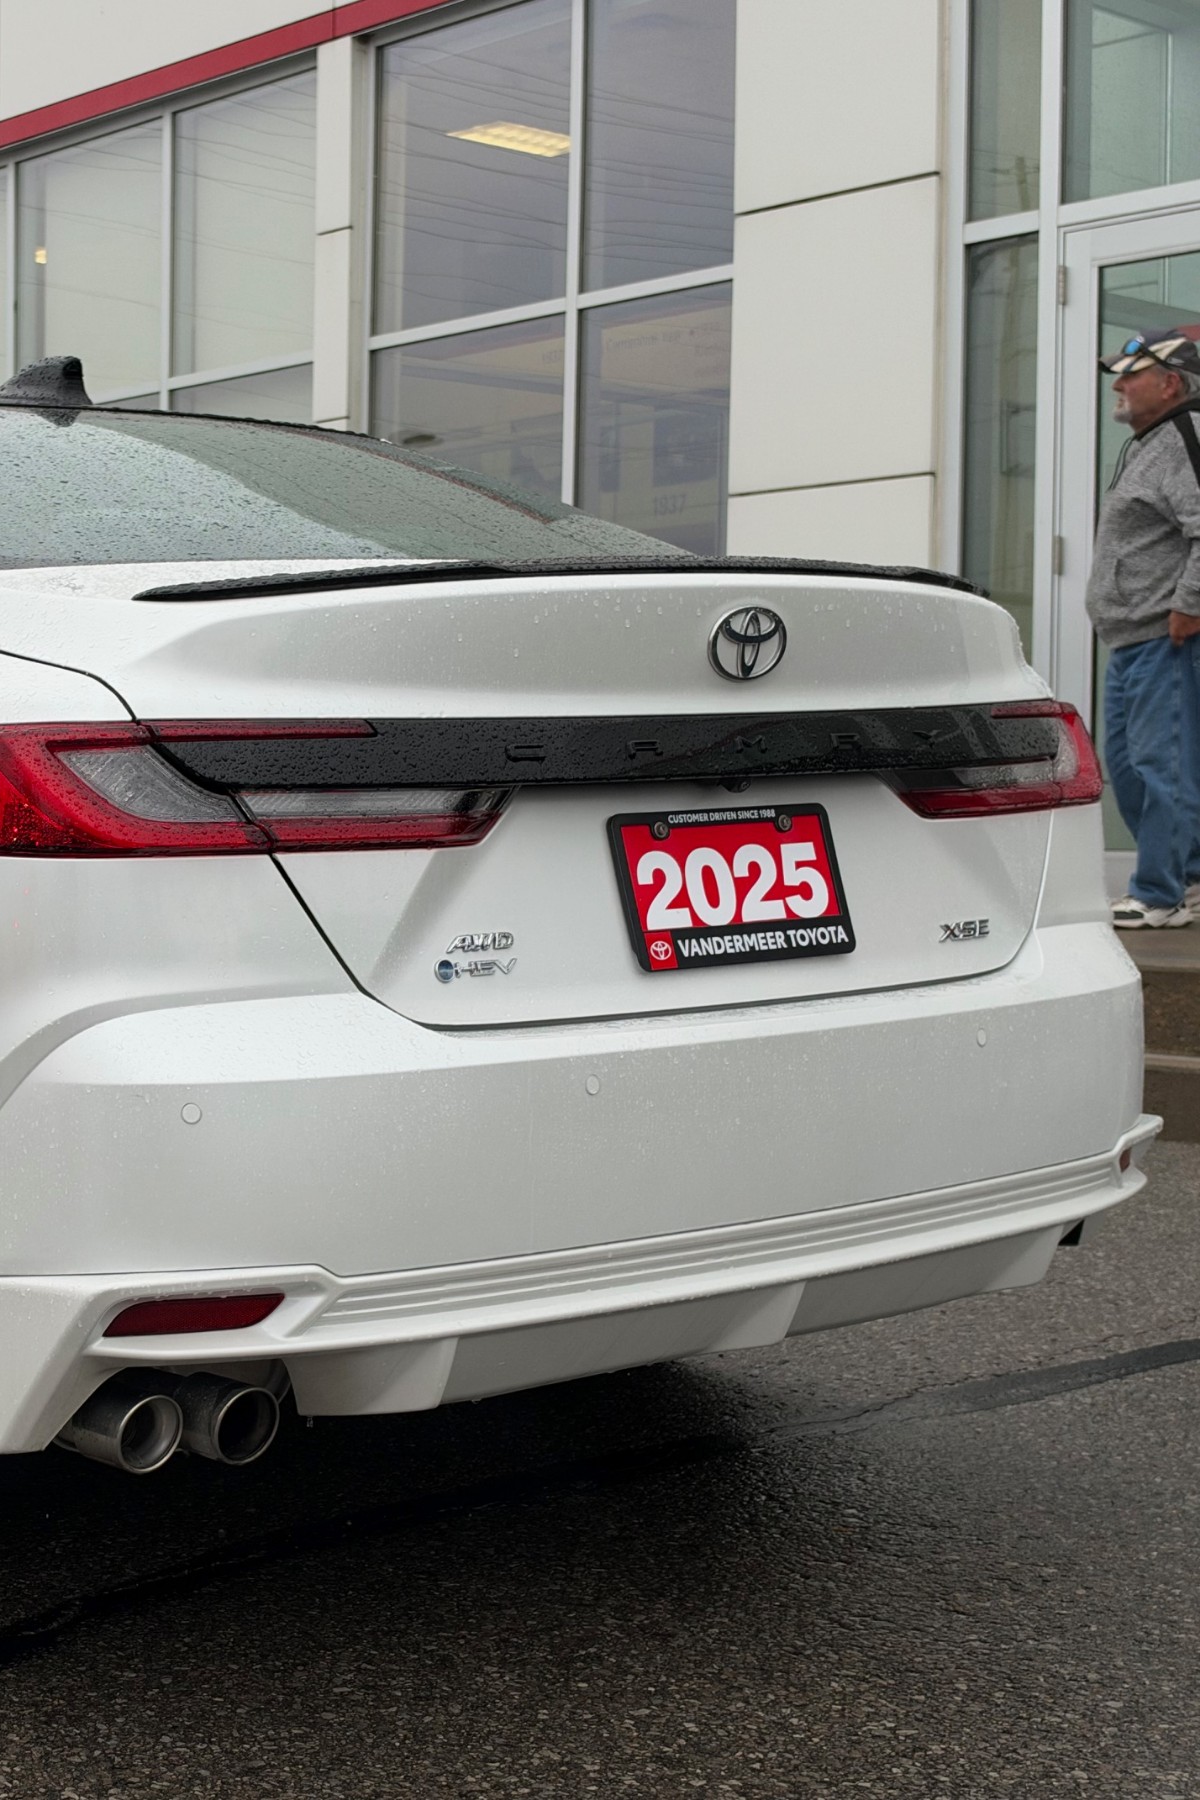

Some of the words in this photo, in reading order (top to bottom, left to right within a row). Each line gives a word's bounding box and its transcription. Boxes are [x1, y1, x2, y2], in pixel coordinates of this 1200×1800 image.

[503, 729, 942, 763] CAMRY
[668, 812, 709, 823] CUSTOMER
[709, 811, 736, 821] DRIVEN
[738, 809, 758, 819] SINCE
[759, 808, 775, 818] 1988
[636, 841, 829, 930] 2025
[445, 931, 514, 954] AWD
[677, 930, 788, 957] VANDERMEER
[788, 925, 849, 948] TOYOTA
[938, 918, 990, 943] XSE
